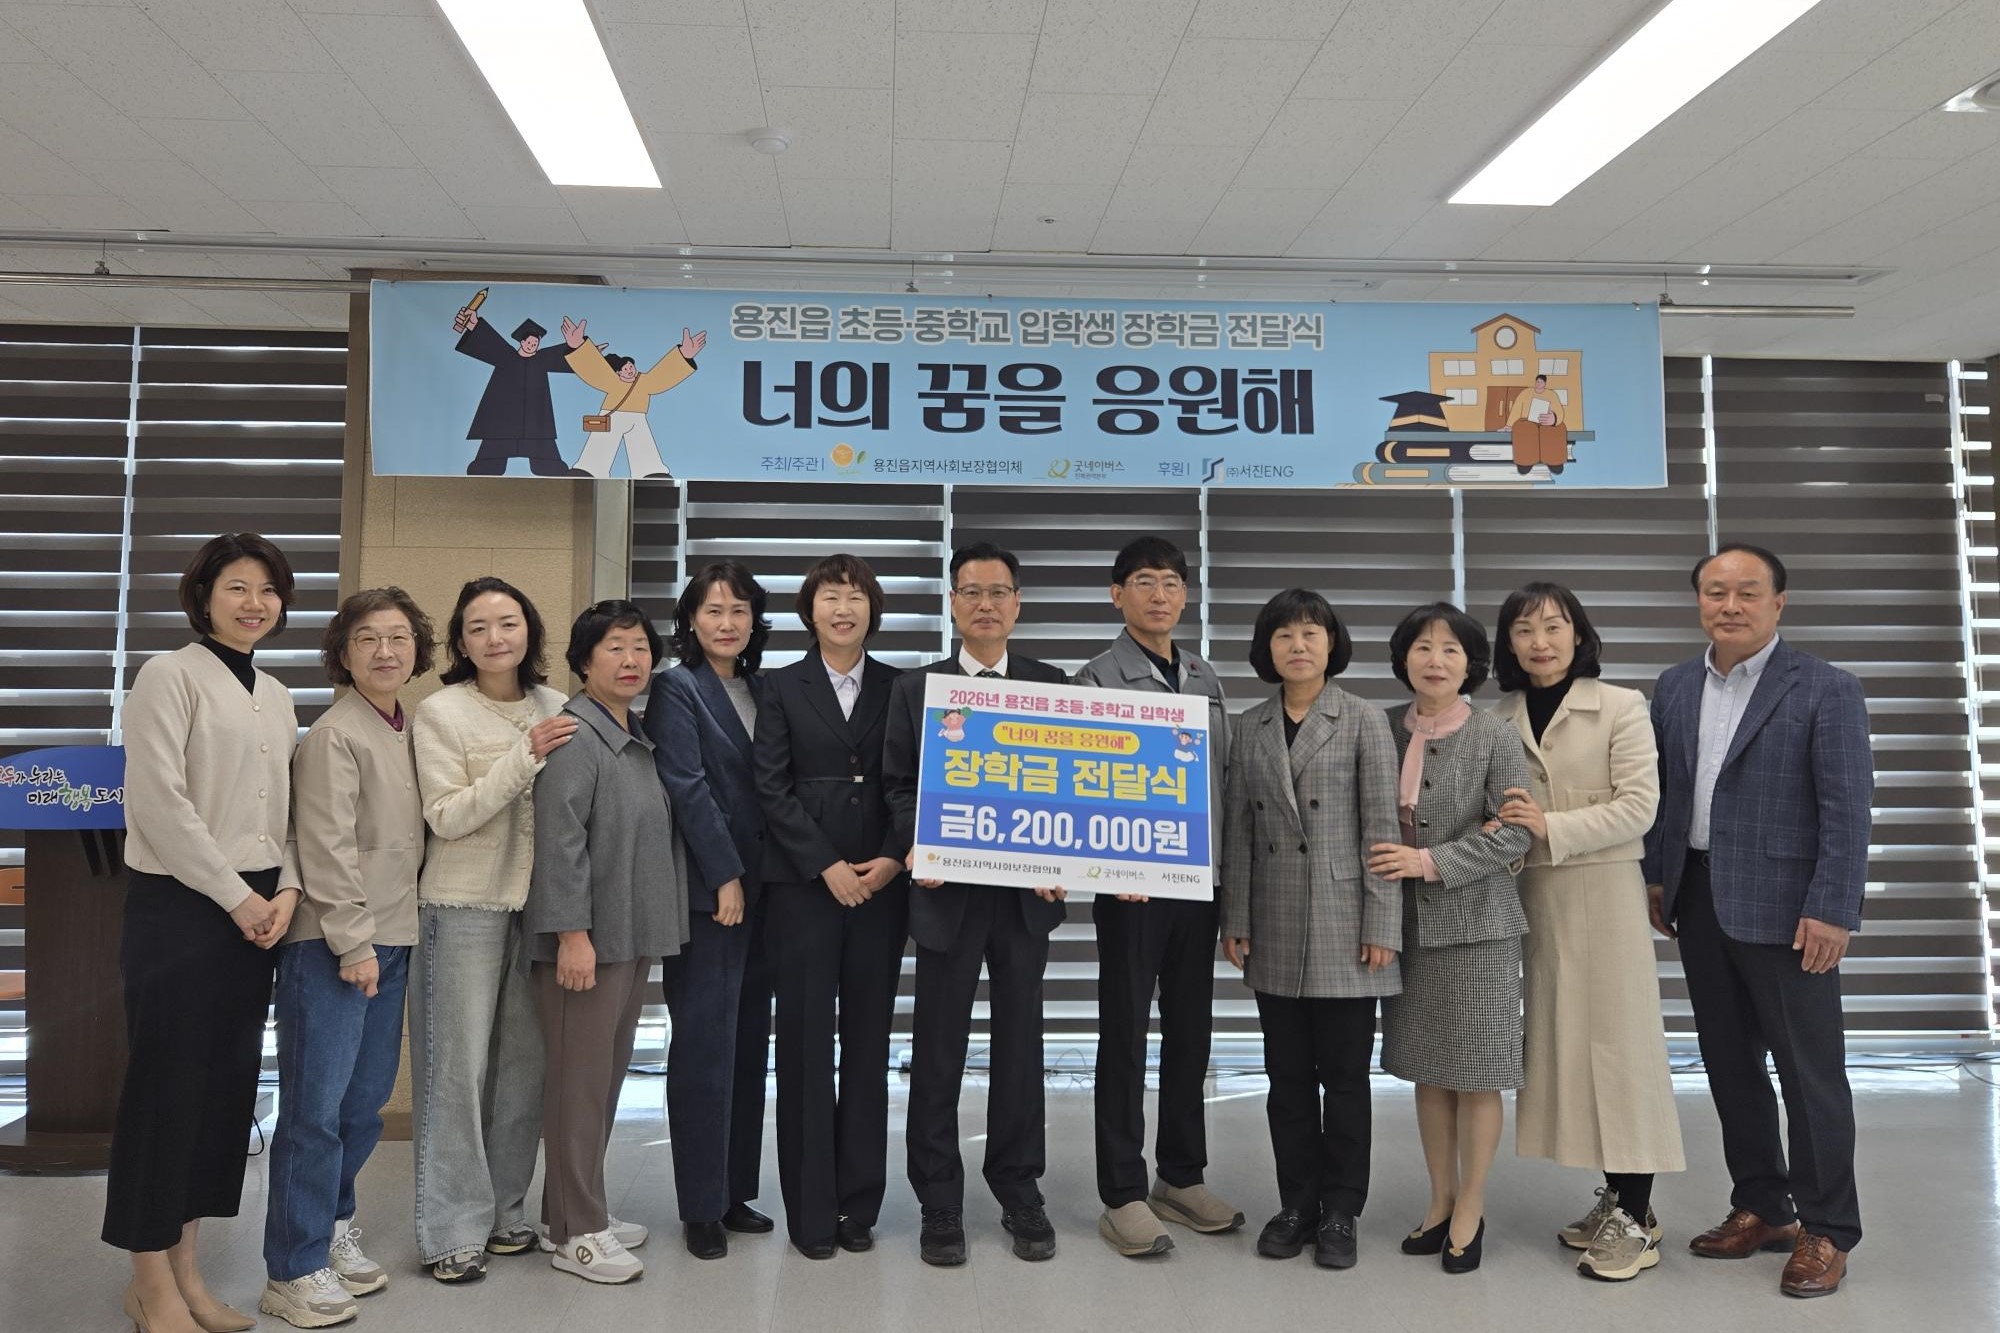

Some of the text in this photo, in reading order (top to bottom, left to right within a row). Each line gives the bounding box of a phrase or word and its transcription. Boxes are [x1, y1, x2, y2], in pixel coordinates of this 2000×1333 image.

[731, 304, 1323, 350] 용진읍 초등·중학교 입학생 장학금 전달식
[742, 360, 1314, 436] 너의 꿈을 응원해
[873, 458, 1023, 475] 용진읍지역사회보장협의체
[1074, 460, 1125, 472] 굿네이버스
[949, 689, 1185, 722] 2026년 용진읍 초등·중학교 입학생
[1044, 730, 1074, 746] 꿈을
[28, 765, 67, 786] 누리는
[944, 750, 1187, 804] 장학금 전달식
[1161, 872, 1200, 884] 서진ENG
